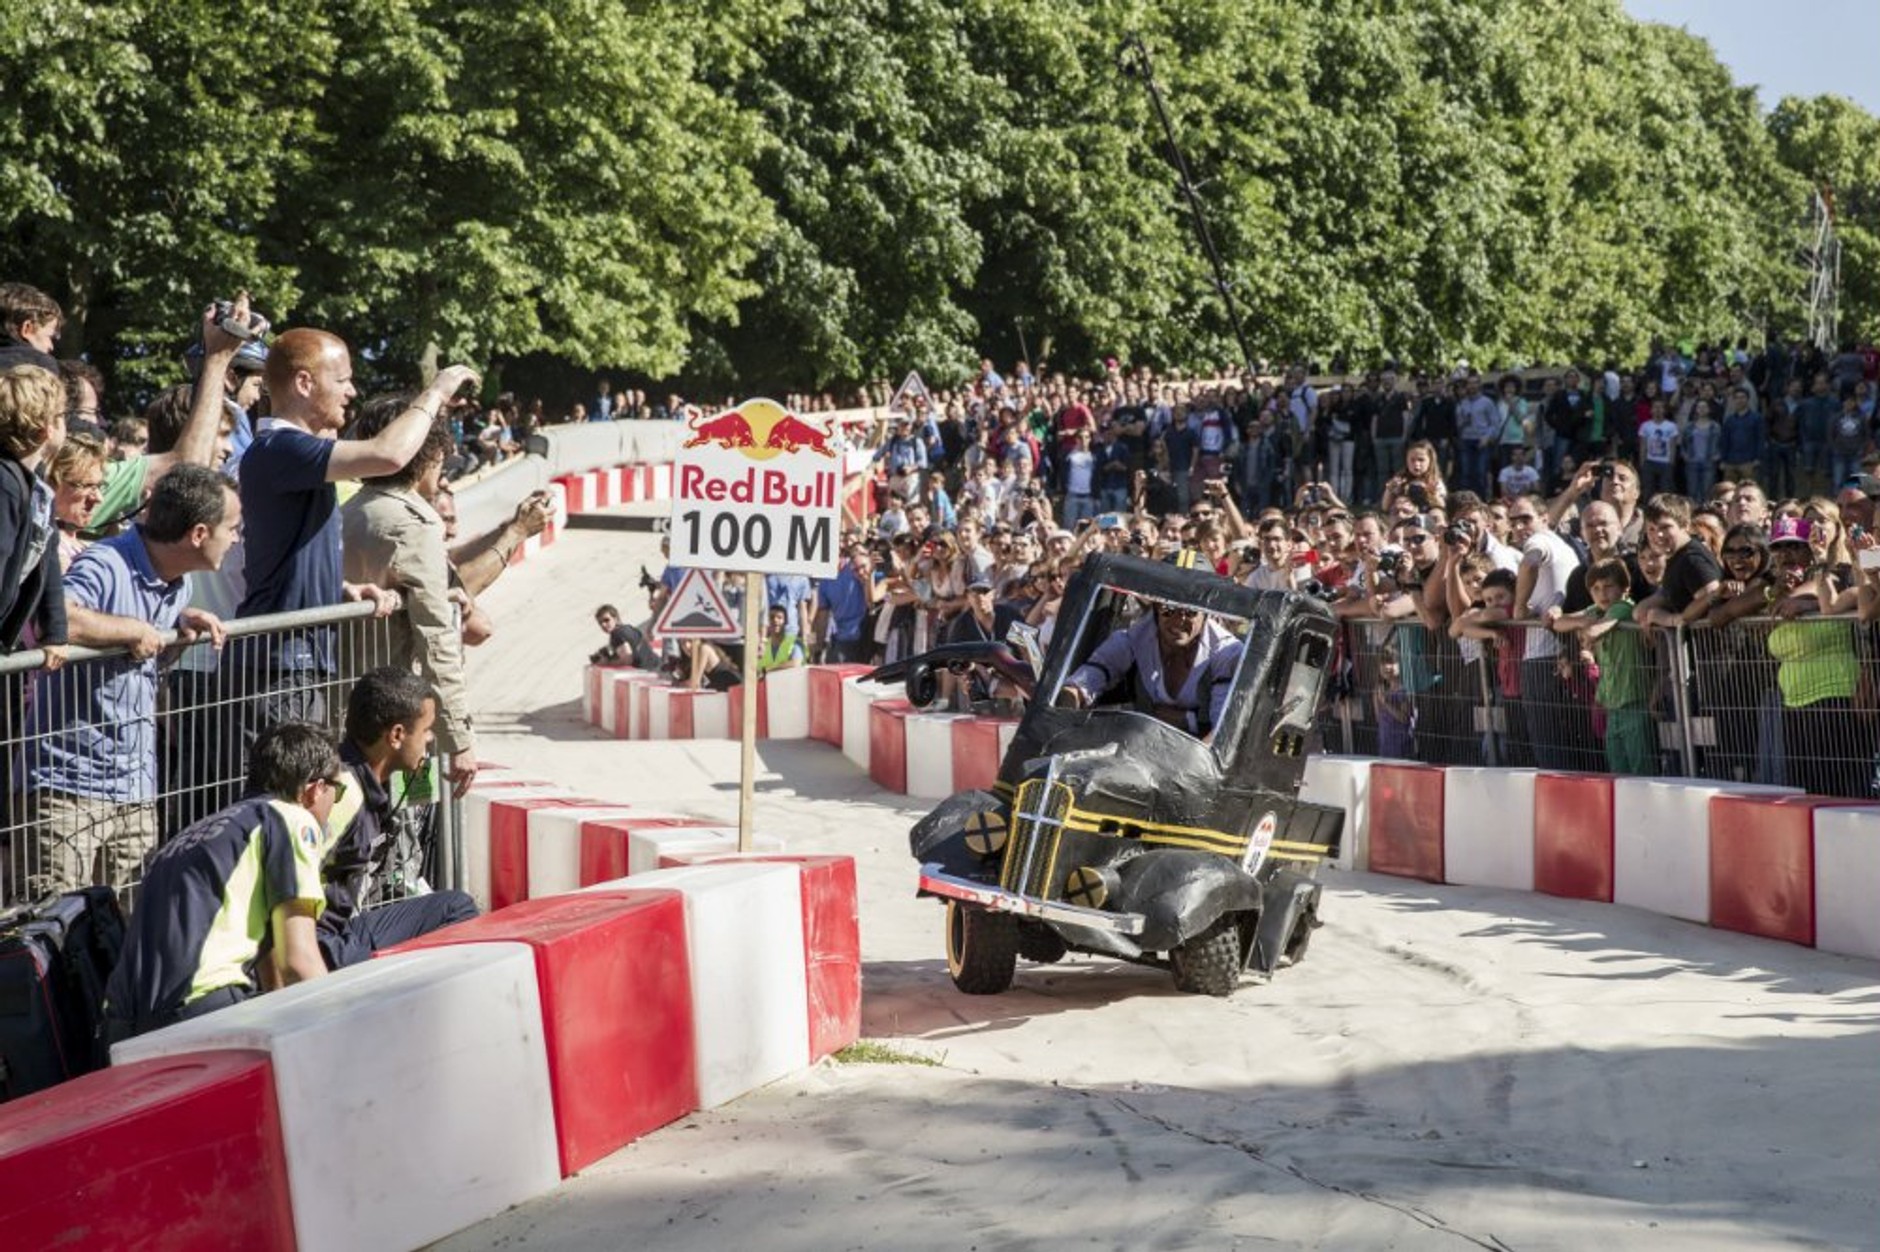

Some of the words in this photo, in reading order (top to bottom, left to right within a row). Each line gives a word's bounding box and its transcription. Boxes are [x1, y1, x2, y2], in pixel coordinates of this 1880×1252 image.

[681, 464, 755, 503] Red
[762, 470, 836, 508] Bull
[682, 510, 772, 559] 100
[786, 515, 831, 563] M
